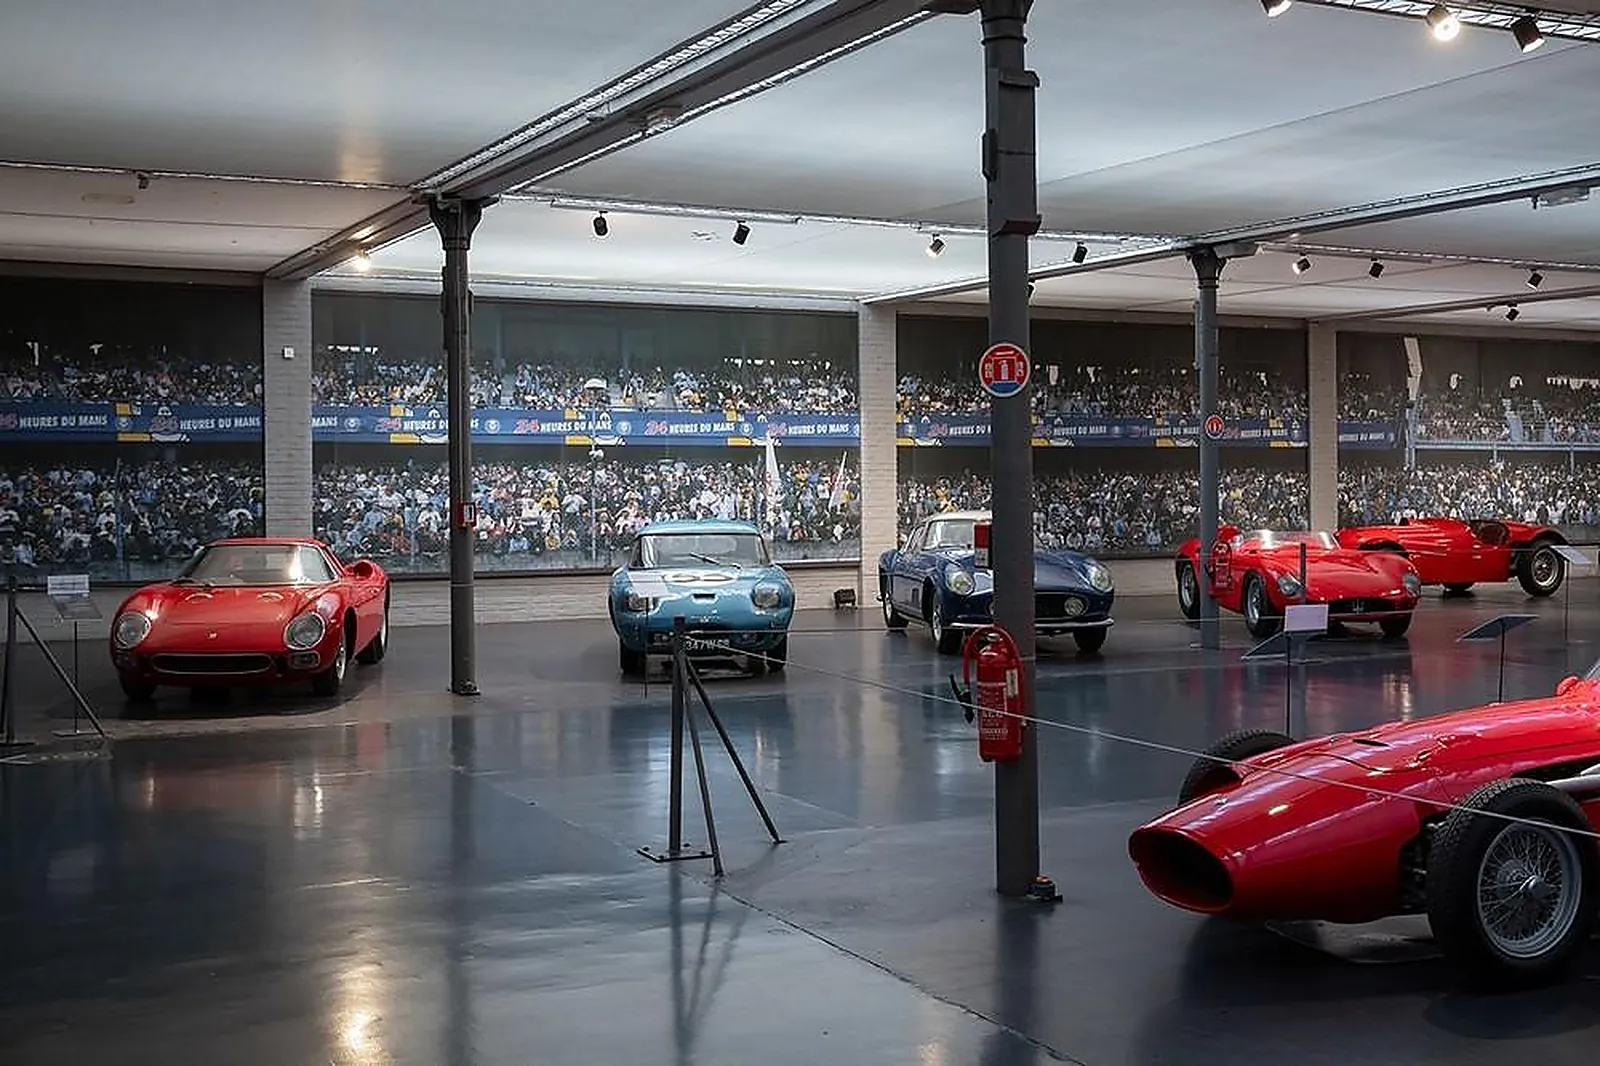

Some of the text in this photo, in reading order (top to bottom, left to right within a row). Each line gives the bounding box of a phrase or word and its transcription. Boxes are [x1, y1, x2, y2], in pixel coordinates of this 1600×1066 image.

[19, 415, 58, 428] HEURES
[60, 415, 77, 427] DU
[78, 413, 108, 426] MANS
[180, 418, 215, 430] HEURES
[218, 417, 232, 429] DU
[234, 416, 262, 428] MANS
[403, 419, 437, 431] HEURES
[540, 421, 572, 433] HEURES
[574, 421, 586, 431] DU
[669, 423, 698, 434] HEURES
[699, 422, 712, 432] DU
[713, 421, 735, 432] MANS
[816, 424, 828, 434] DU
